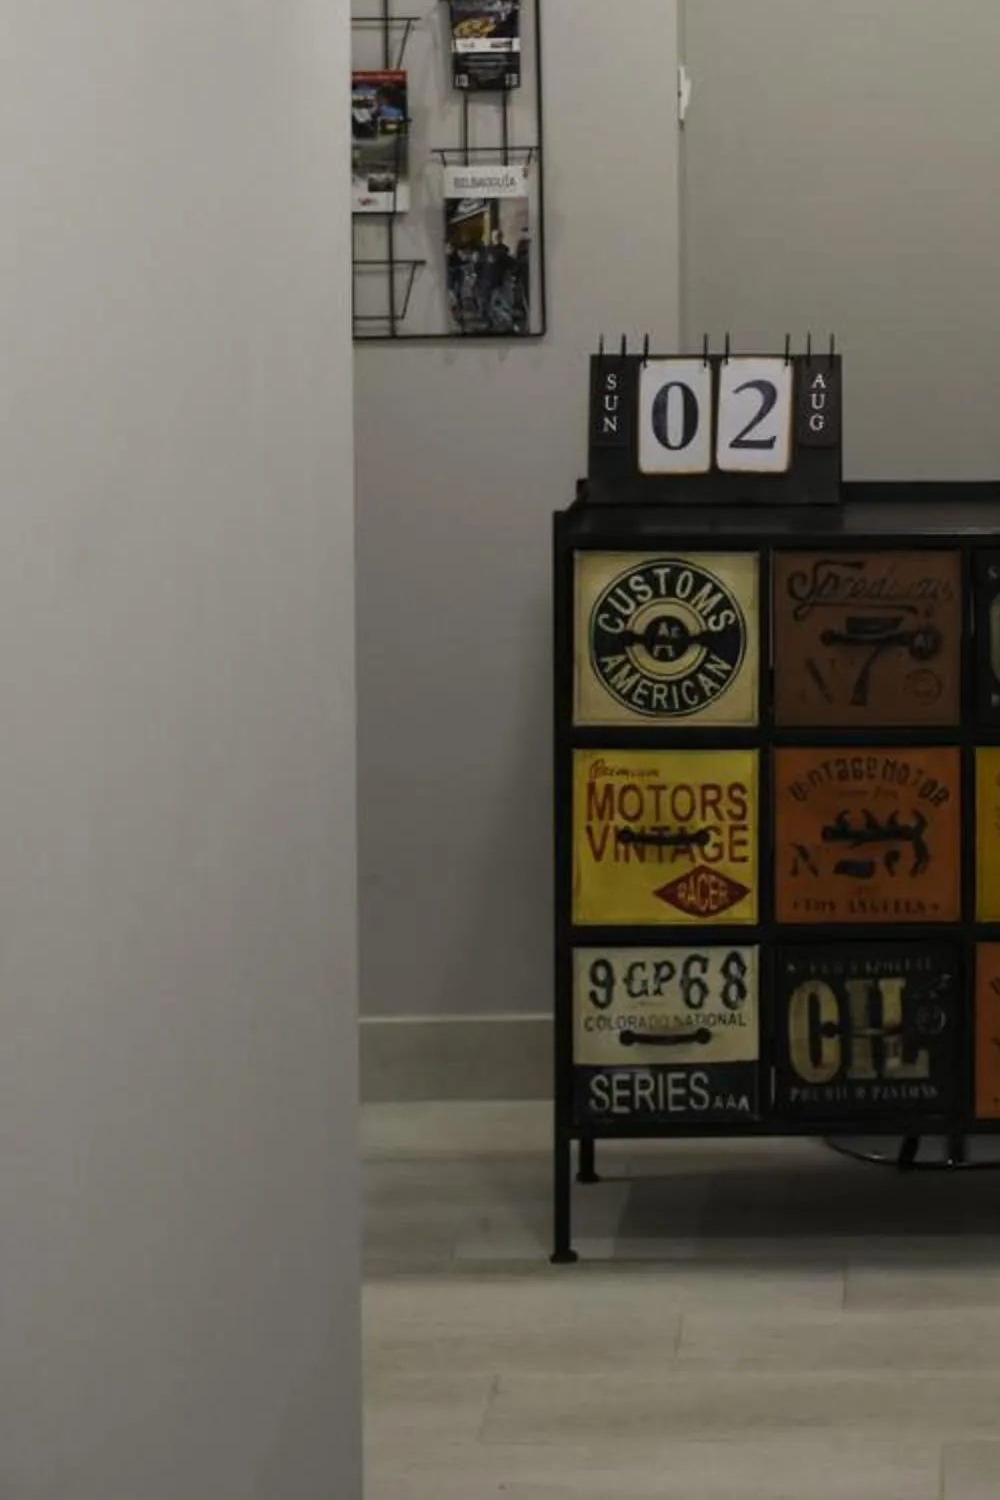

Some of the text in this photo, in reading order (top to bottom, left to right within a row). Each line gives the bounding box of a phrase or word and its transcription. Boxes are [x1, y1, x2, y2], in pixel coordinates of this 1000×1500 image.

[603, 372, 619, 433] SUN
[809, 373, 827, 432] AUG
[597, 566, 736, 634] CUSTOMS
[599, 651, 733, 709] AMERICAN
[587, 782, 748, 822] MOTORS
[586, 824, 749, 863] VINTAGE
[676, 872, 728, 913] RACER
[584, 1011, 747, 1032] COLORADO NATIONAL
[588, 1071, 710, 1114] SERIES
